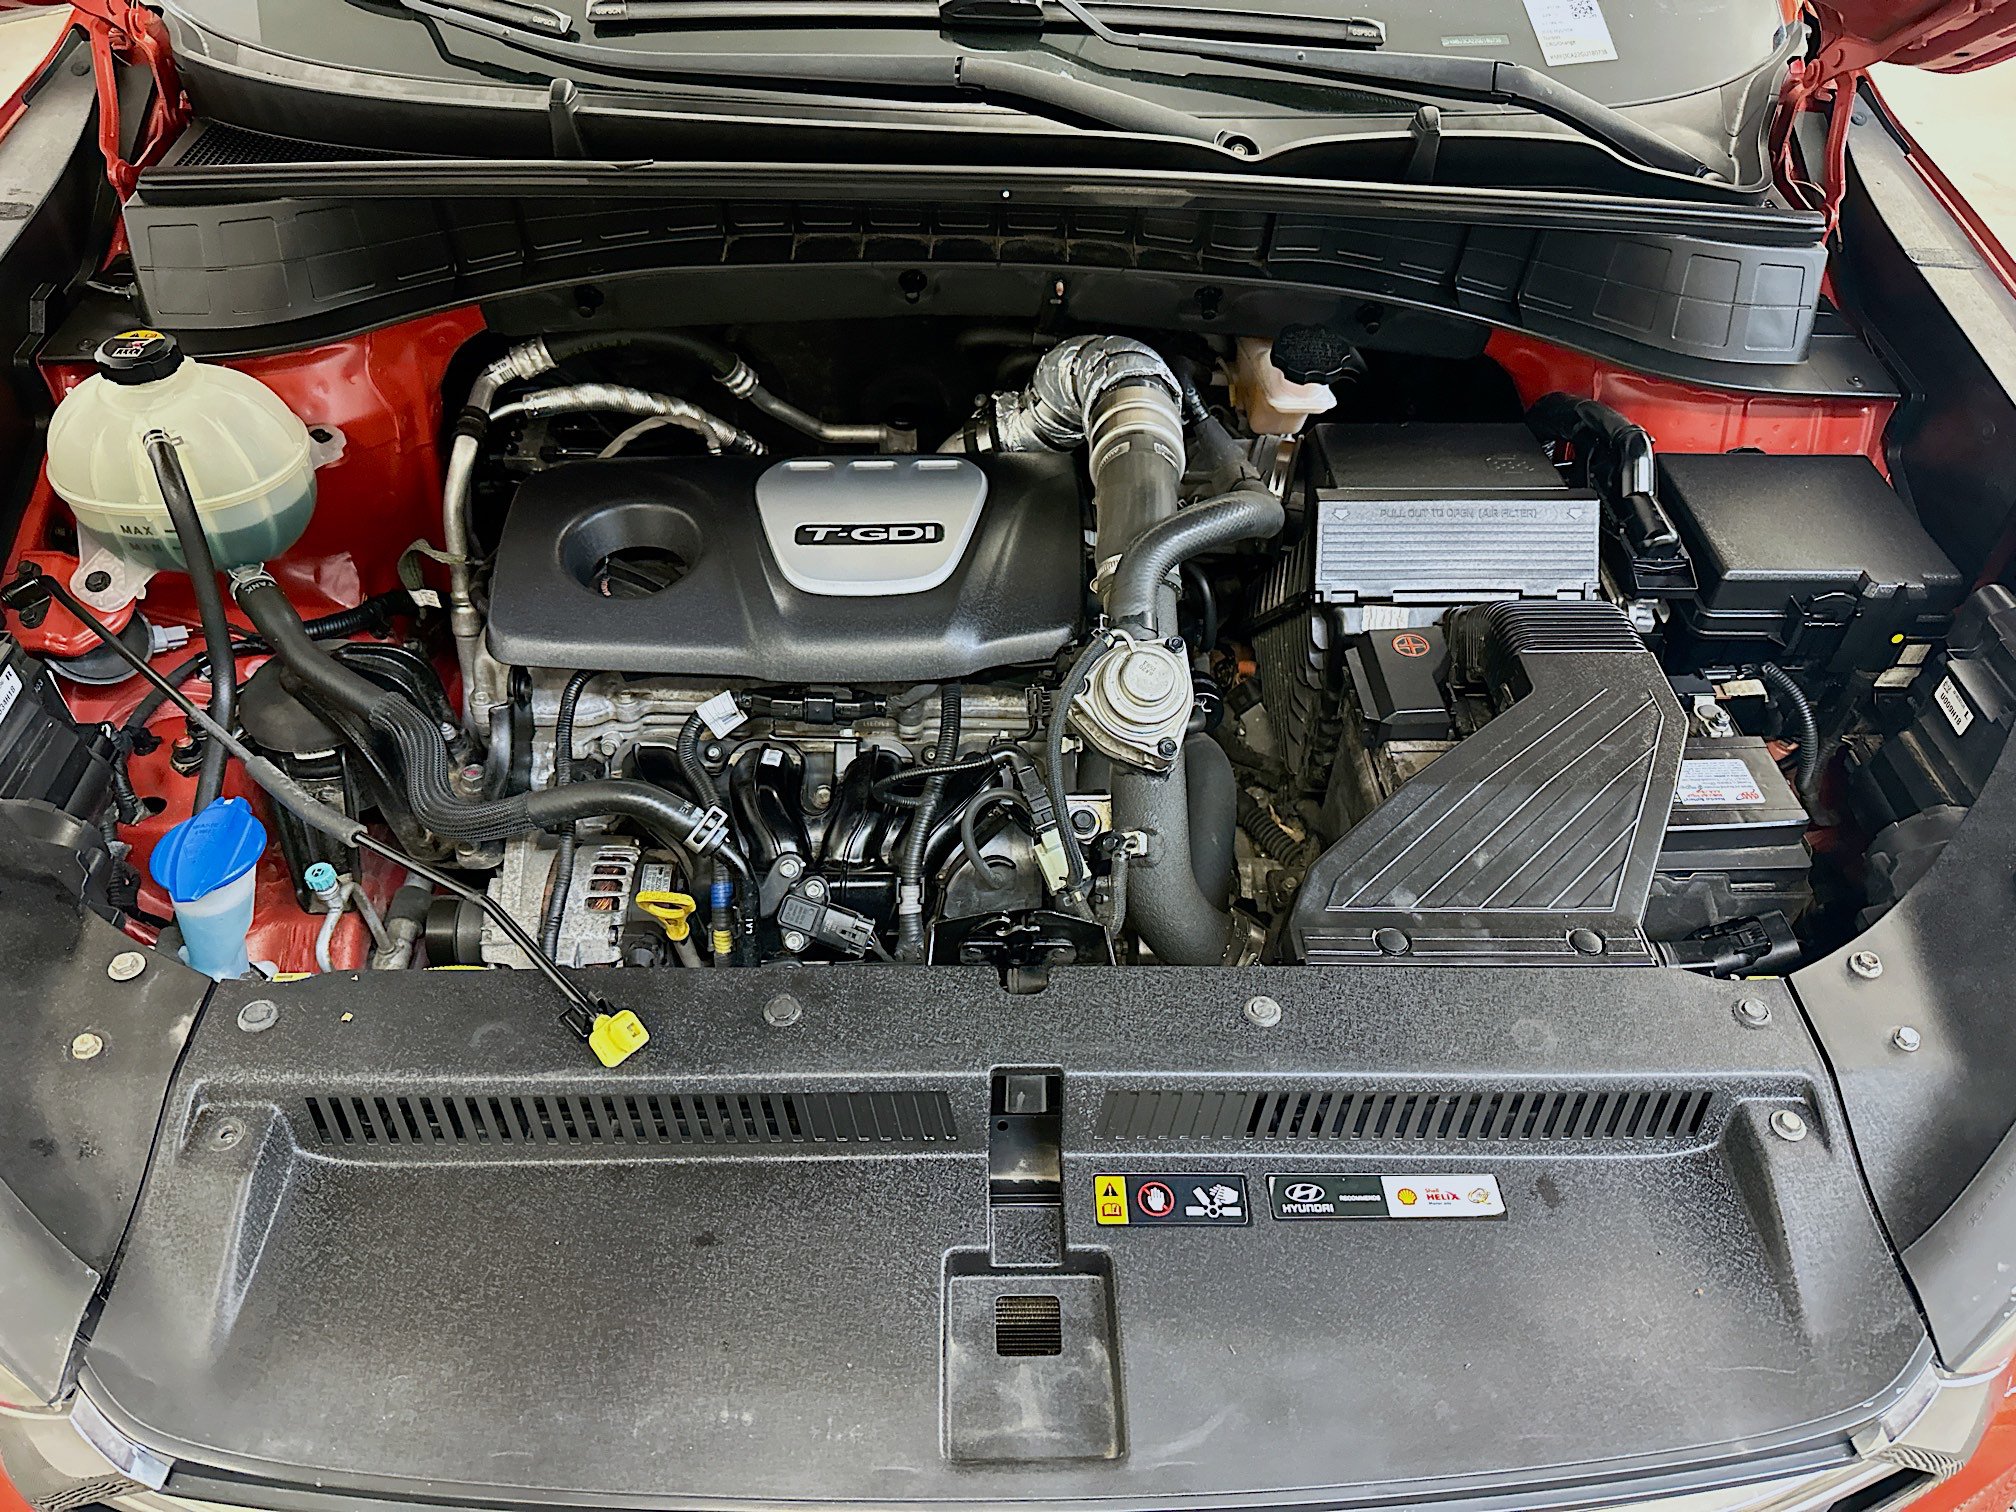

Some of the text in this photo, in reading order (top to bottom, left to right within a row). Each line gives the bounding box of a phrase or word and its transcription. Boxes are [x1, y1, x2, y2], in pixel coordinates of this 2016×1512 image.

[120, 524, 154, 536] MAX
[805, 525, 936, 541] T-GDI
[128, 542, 163, 552] MIN
[244, 580, 276, 595] TANK
[1426, 1190, 1461, 1201] HELIX
[1281, 1203, 1335, 1214] HYUNDAI
